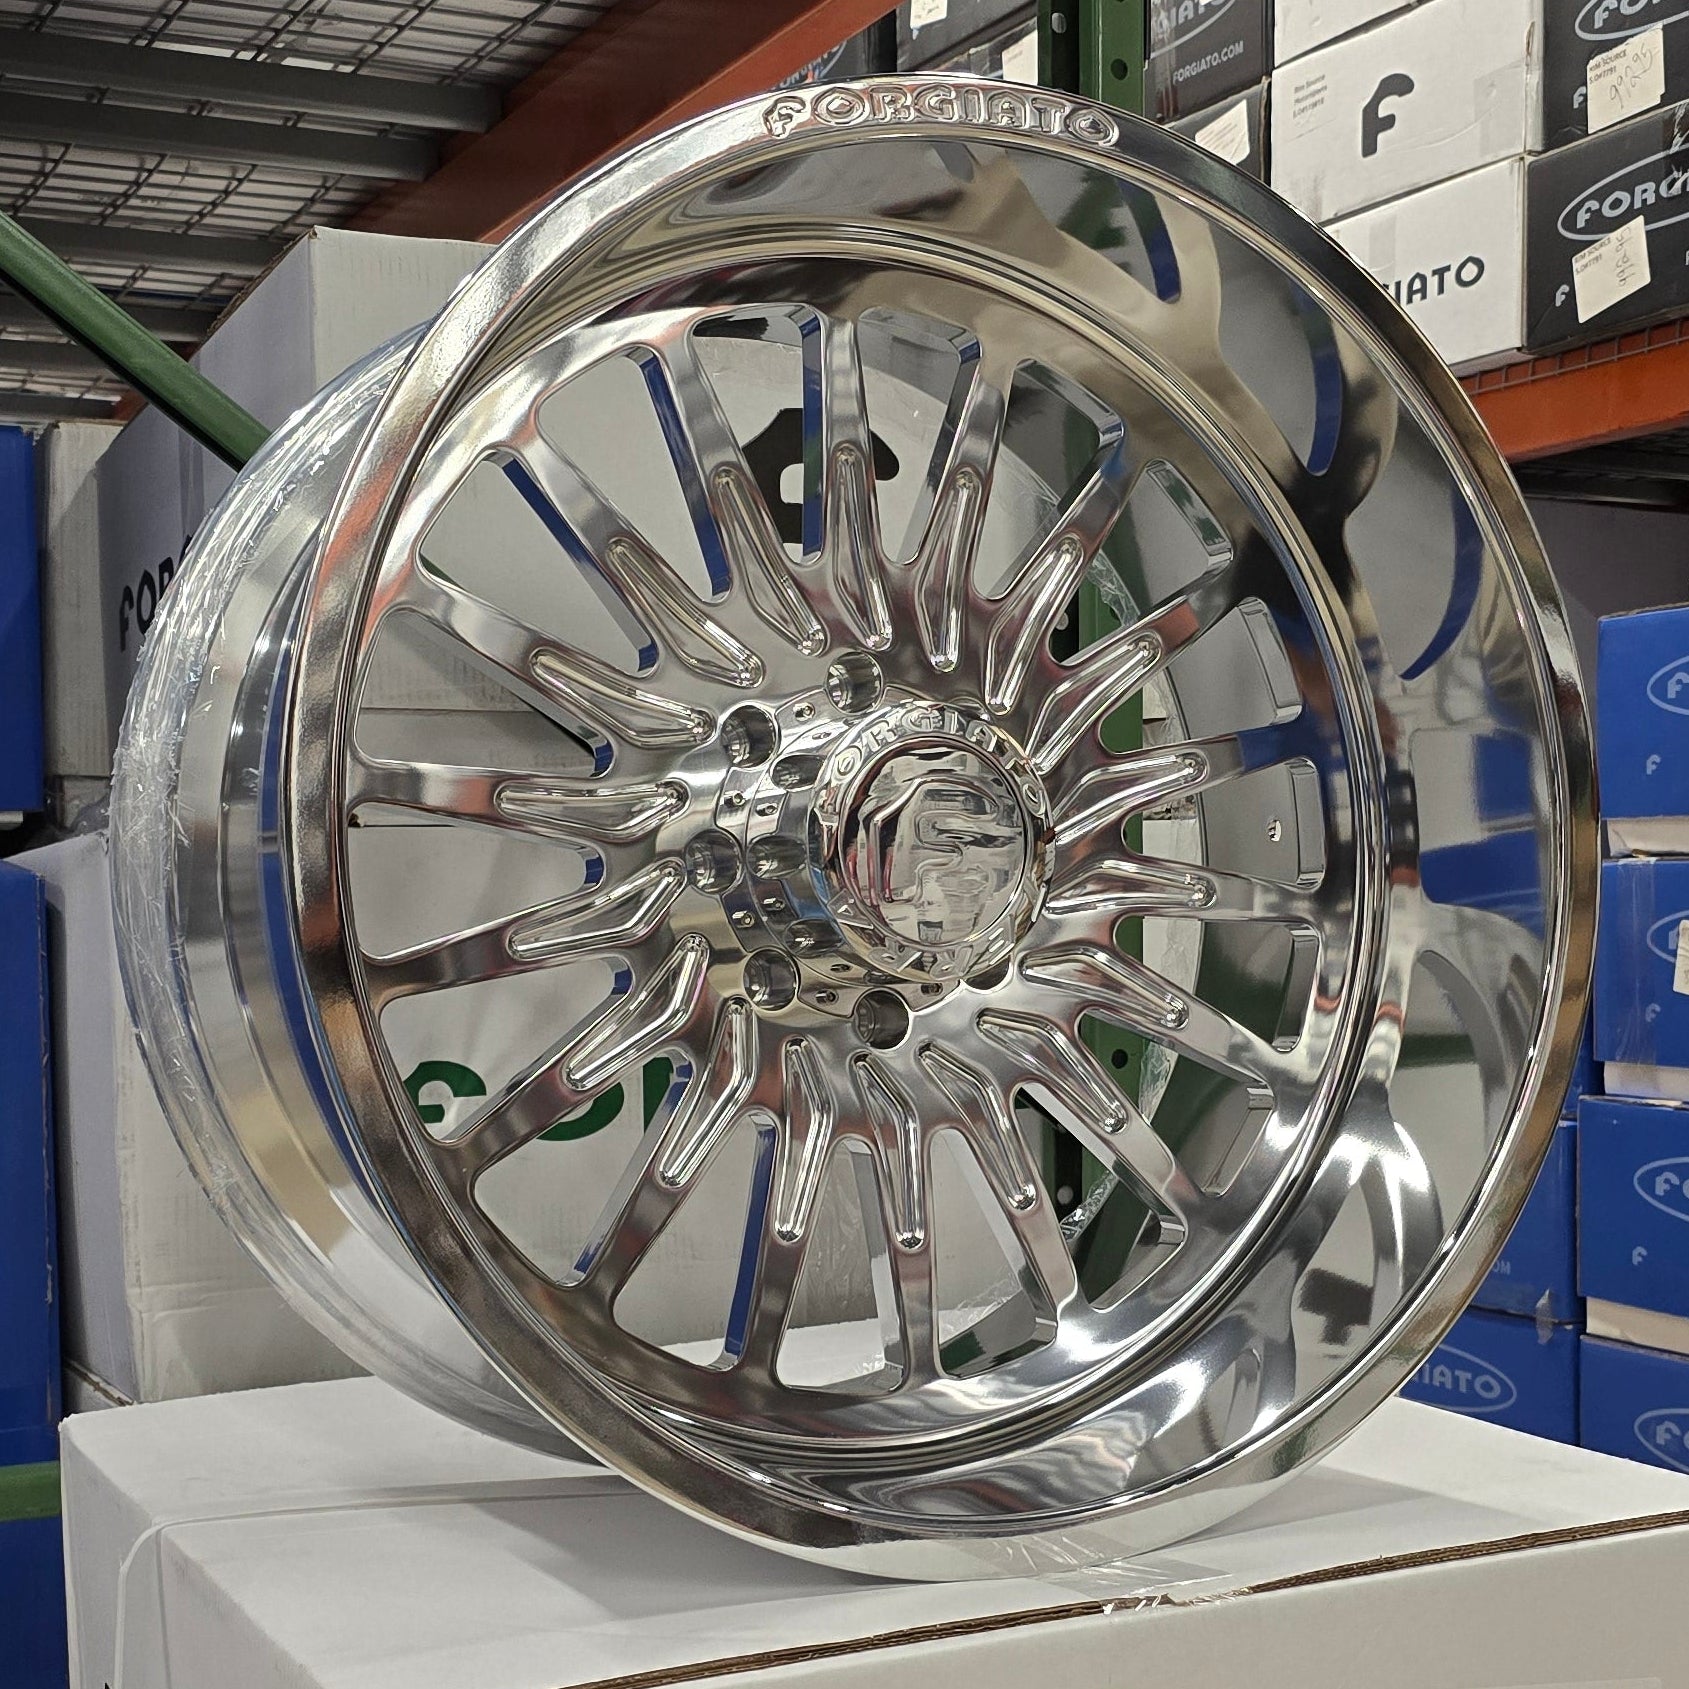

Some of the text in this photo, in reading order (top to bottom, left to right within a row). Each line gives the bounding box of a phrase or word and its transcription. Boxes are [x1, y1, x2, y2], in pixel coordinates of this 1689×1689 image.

[1172, 40, 1244, 85] FORGIATO.COM
[762, 84, 1122, 147] FORGIATO
[1383, 255, 1485, 305] IATO
[1410, 1362, 1502, 1399] IATO
